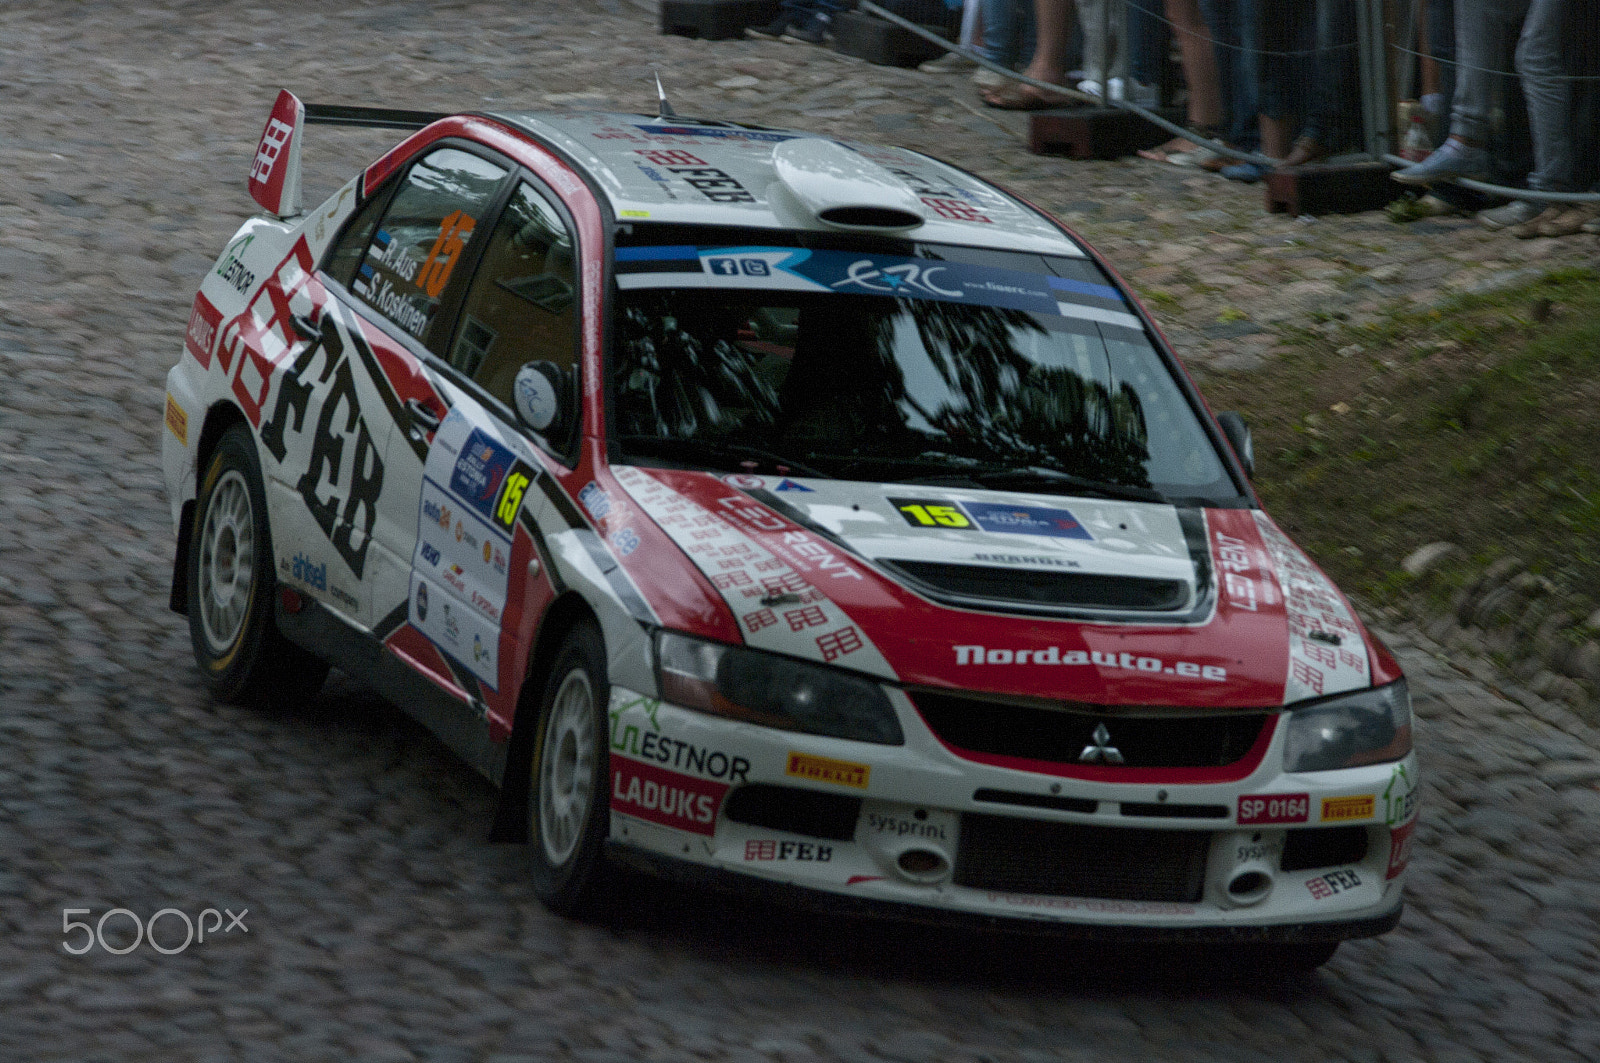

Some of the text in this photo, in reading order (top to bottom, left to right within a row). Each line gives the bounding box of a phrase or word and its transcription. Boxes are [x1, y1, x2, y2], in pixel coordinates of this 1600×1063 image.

[416, 209, 477, 297] 15
[261, 313, 384, 581] FEB
[498, 472, 529, 525] 15
[900, 504, 970, 528] 15
[784, 531, 863, 580] RENT
[1216, 531, 1250, 572] RENT
[642, 732, 750, 783] ESTNOR
[789, 756, 865, 785] PIRELLI
[614, 771, 713, 824] LADUKS
[1240, 798, 1306, 819] SP 0164
[778, 841, 832, 861] FEB
[1323, 870, 1362, 893] FEB
